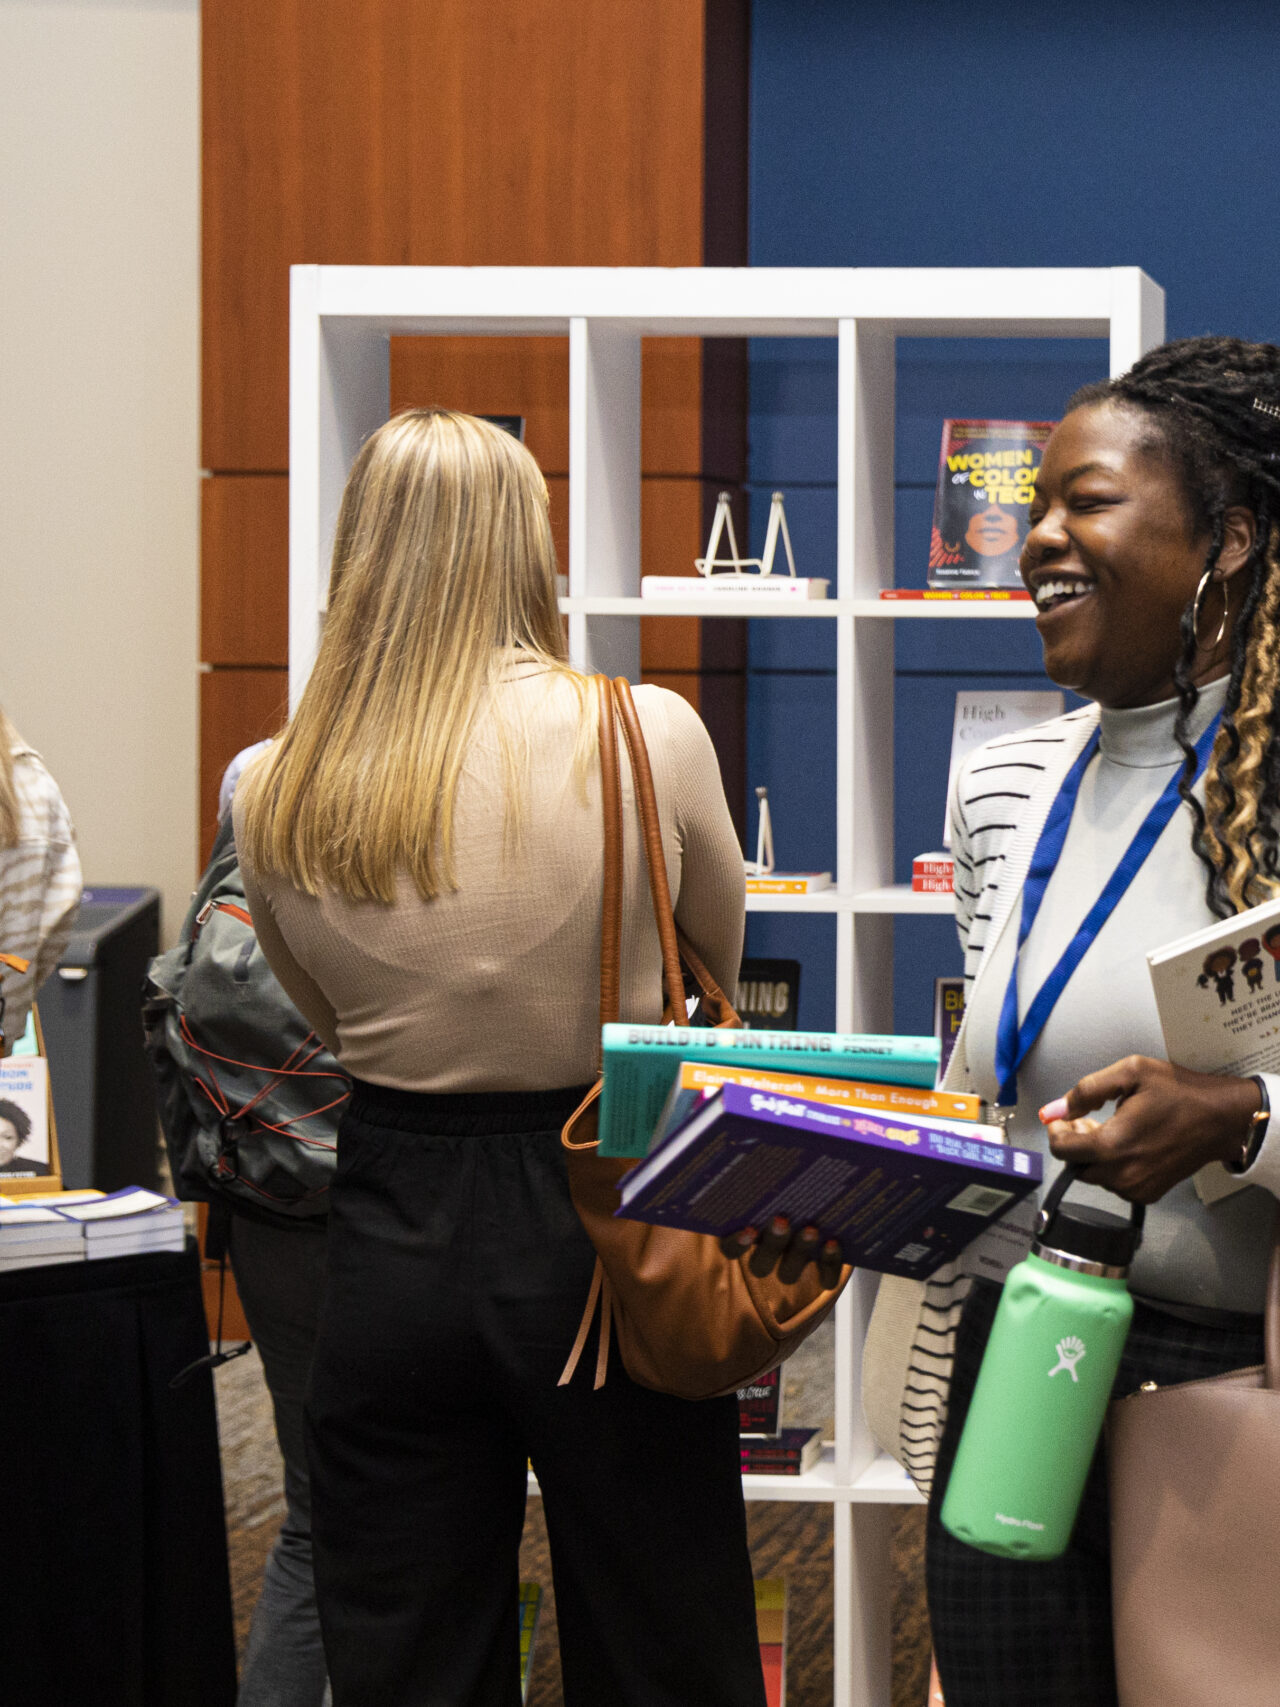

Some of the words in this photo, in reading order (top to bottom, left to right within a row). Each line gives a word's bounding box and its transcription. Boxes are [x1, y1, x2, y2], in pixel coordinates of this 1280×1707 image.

[947, 449, 1033, 471] WOMEN
[962, 704, 1006, 723] High
[923, 862, 949, 876] High
[922, 878, 949, 892] High
[628, 1028, 689, 1046] BUILD
[767, 1033, 833, 1053] THING
[814, 1084, 851, 1098] More
[854, 1088, 887, 1103] Than
[890, 1092, 939, 1111] Enough
